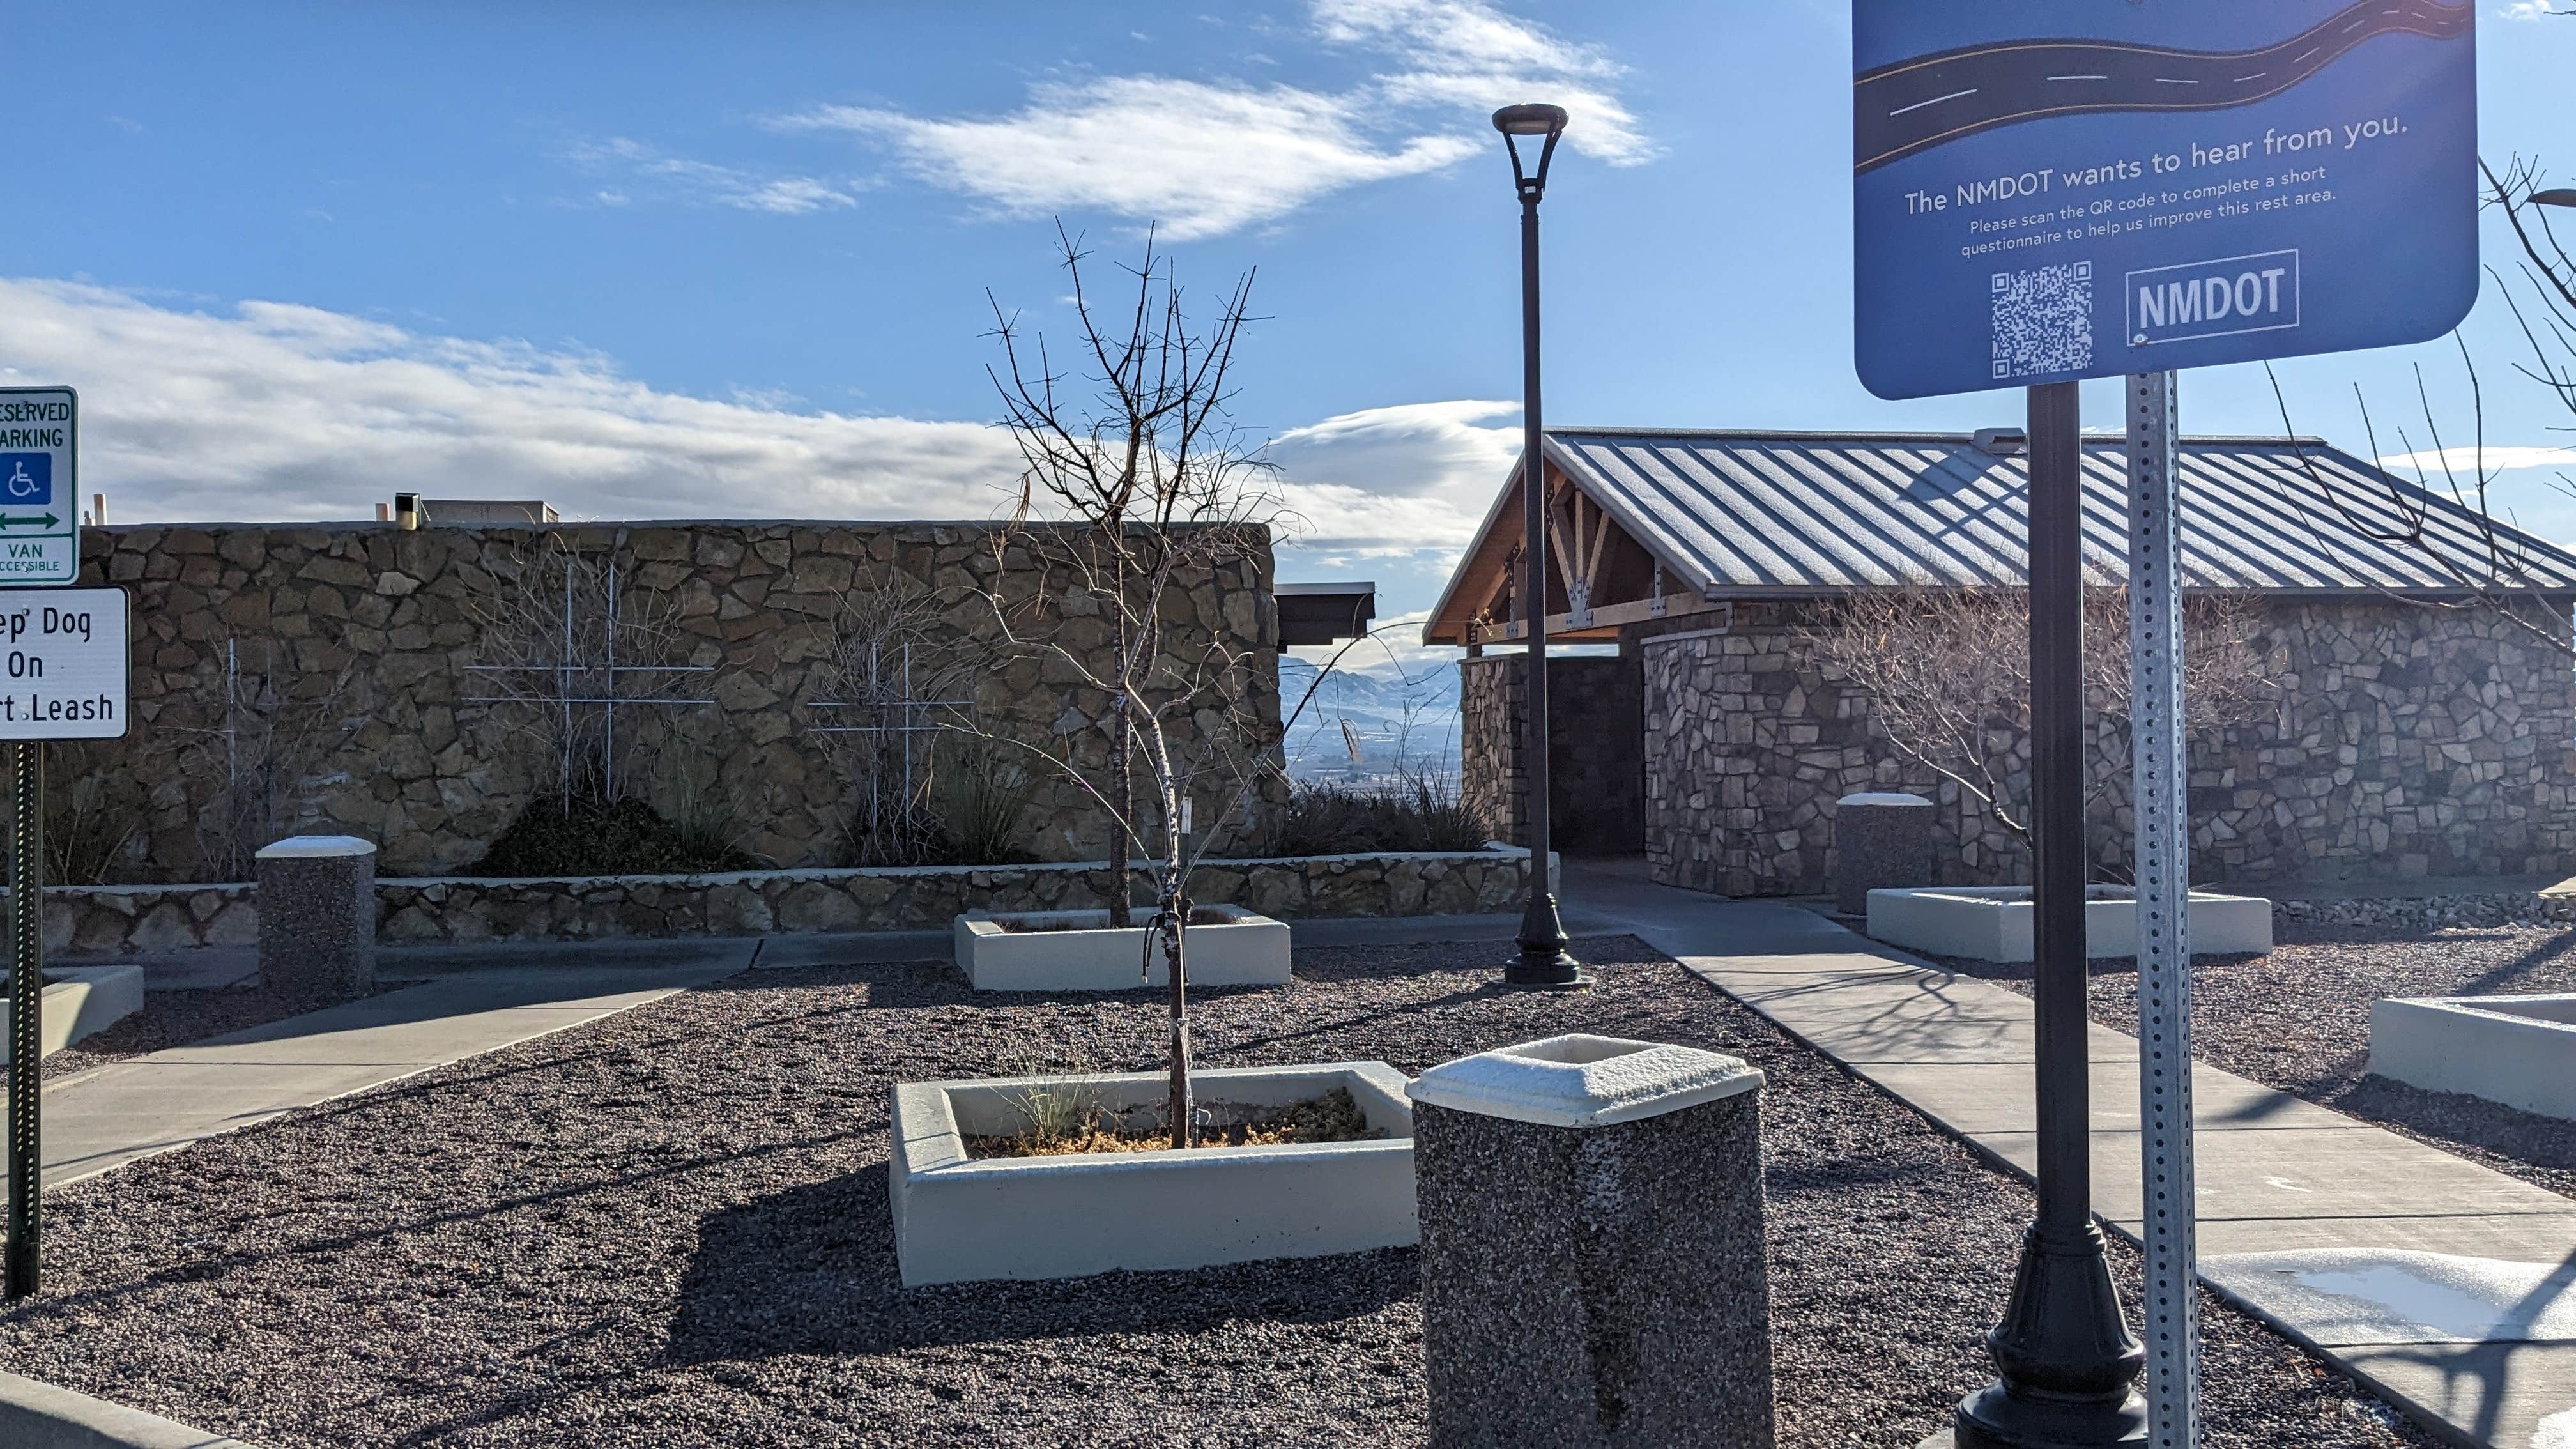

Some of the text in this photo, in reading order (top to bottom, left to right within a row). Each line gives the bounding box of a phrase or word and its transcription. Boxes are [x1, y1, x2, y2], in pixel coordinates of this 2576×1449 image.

[1905, 116, 2407, 215] The NMDOT wants to hear from you.
[1970, 166, 2326, 234] Please scan the QR code to complete a short
[1961, 190, 2336, 259] questionnaire to help us improve this rest area.
[2140, 267, 2285, 328] NMDOT
[8, 544, 42, 558] VAN
[43, 607, 91, 643] Dog
[8, 650, 43, 678] On
[33, 693, 112, 721] Leash
